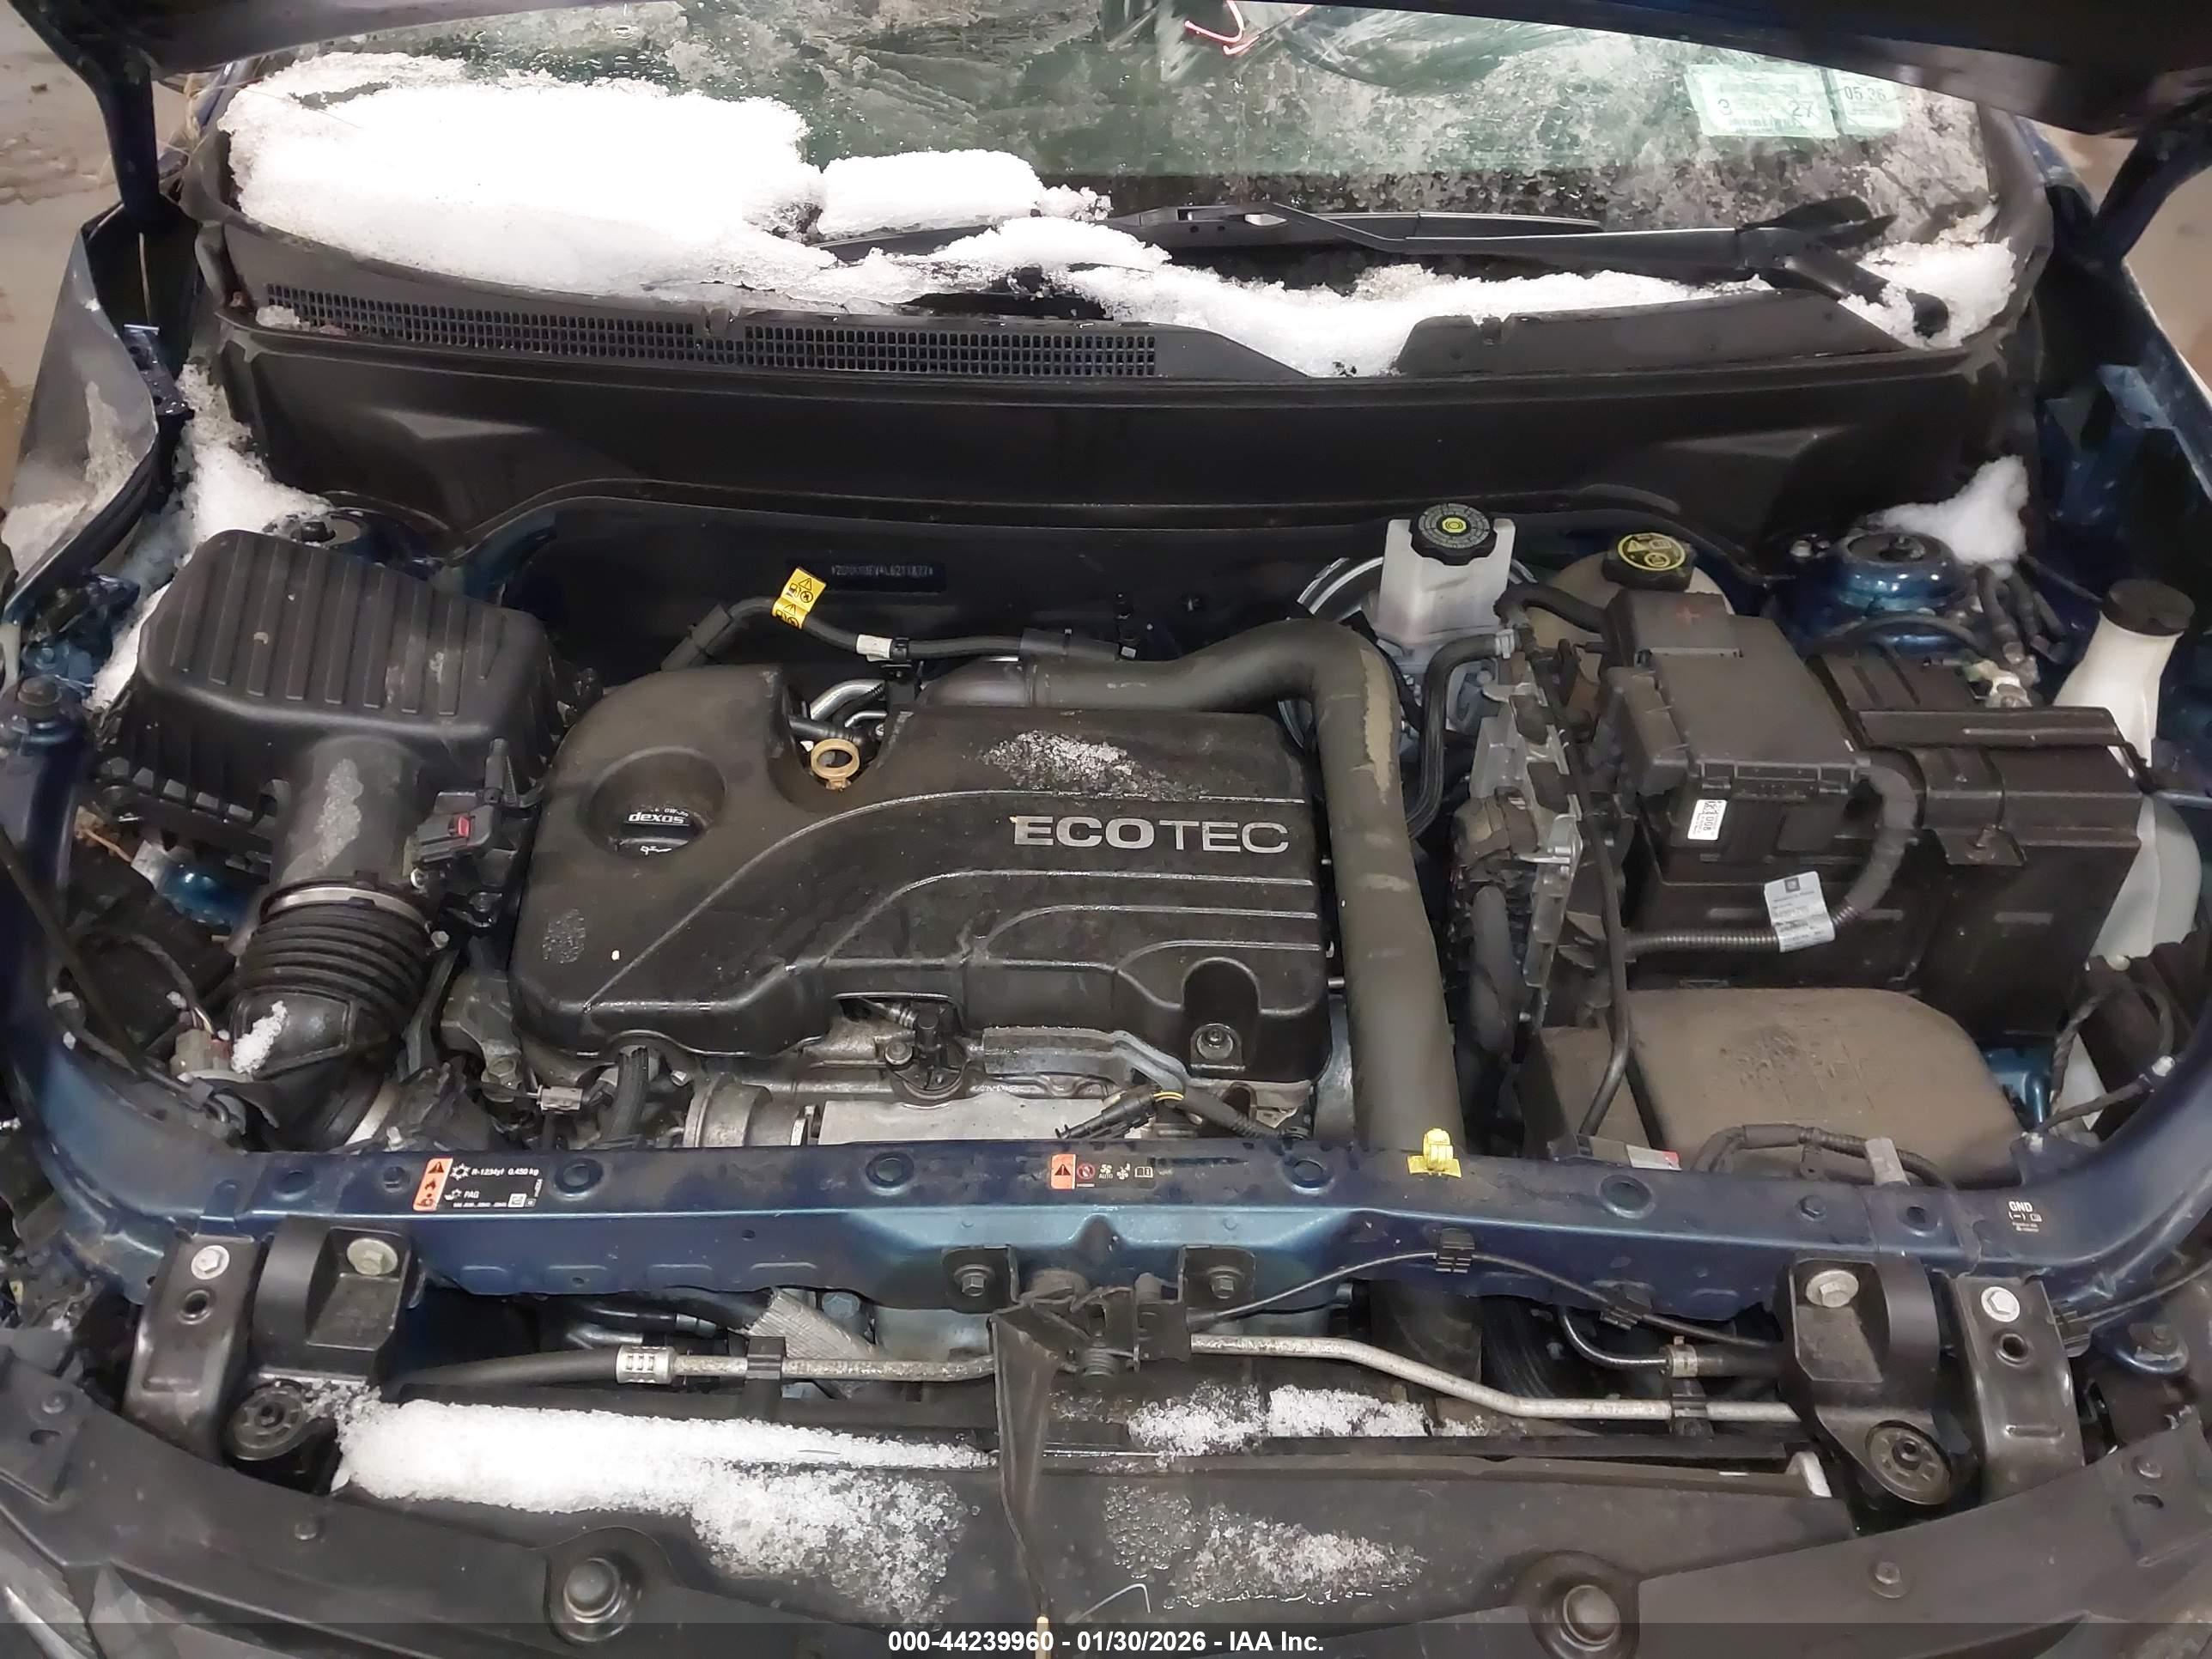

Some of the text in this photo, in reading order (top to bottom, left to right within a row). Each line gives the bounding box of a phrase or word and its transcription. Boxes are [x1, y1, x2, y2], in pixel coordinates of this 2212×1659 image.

[1844, 86, 1863, 100] 05
[1717, 98, 1733, 116] 3
[1789, 100, 1814, 118] 27
[629, 811, 686, 824] dexos
[1013, 815, 1289, 854] ECOTEC
[471, 1168, 504, 1176] R-1234yf
[529, 1168, 539, 1176] kg
[464, 1190, 480, 1199] PAG
[2008, 1200, 2033, 1212] GND
